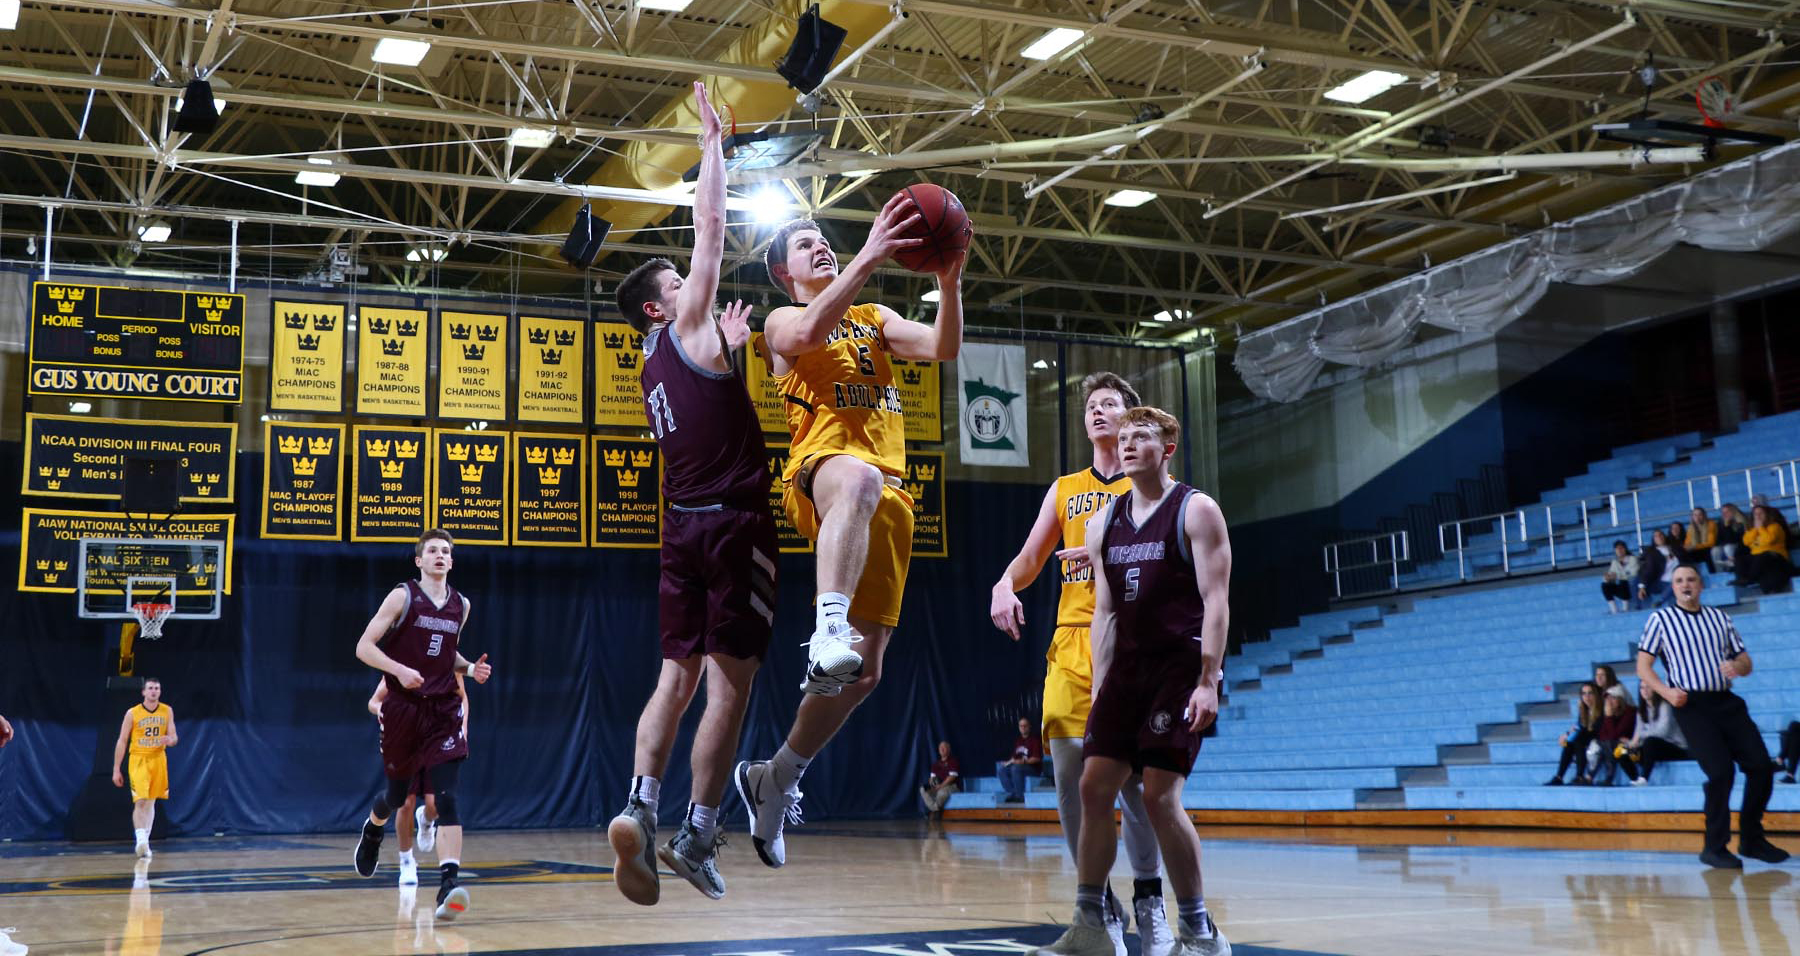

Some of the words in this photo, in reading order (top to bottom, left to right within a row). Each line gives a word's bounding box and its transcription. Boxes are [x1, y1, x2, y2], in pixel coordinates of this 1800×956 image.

[42, 315, 84, 328] HOME
[122, 325, 158, 334] PERIOD
[190, 324, 240, 336] VISITOR
[97, 334, 120, 342] POSS
[159, 337, 181, 346] POSS
[94, 347, 122, 356] BONUS
[156, 350, 184, 359] BONUS
[291, 356, 326, 366] 1974-75
[858, 344, 876, 377] 5
[376, 362, 409, 370] 1987-88
[458, 367, 490, 375] 1990-91
[536, 370, 567, 378] 1991-92
[34, 368, 78, 390] GUS
[82, 371, 158, 393] YOUNG
[166, 375, 238, 396] COURT
[380, 374, 404, 382] MIAC
[278, 380, 336, 389] CHAMPIONS
[364, 384, 420, 394] CHAMPIONS
[540, 381, 562, 389] MIAC
[445, 388, 500, 397] CHAMPIONS
[524, 391, 578, 401] CHAMPIONS
[601, 395, 644, 404] CHAMPIO
[648, 382, 678, 439] 11
[41, 435, 76, 447] NCAA
[79, 438, 133, 450] DIVISION
[136, 440, 147, 450] III
[150, 441, 185, 452] FINAL
[188, 443, 221, 453] FOUR
[73, 452, 117, 464] Second
[82, 469, 116, 480] Men's
[273, 503, 333, 513] CHAMPIONS
[362, 506, 420, 515] CHAMPIONS
[443, 509, 500, 518] CHAMPIONS
[523, 512, 577, 521] CHAMPIONS
[602, 514, 656, 522] CHAMPIONS
[38, 519, 67, 528] AIAW
[70, 521, 126, 531] NATIONAL
[170, 524, 220, 533] COLLEGE
[123, 556, 170, 566] SIXEN
[1125, 568, 1140, 601] 5
[427, 634, 443, 656] 3
[145, 726, 160, 737] 20
